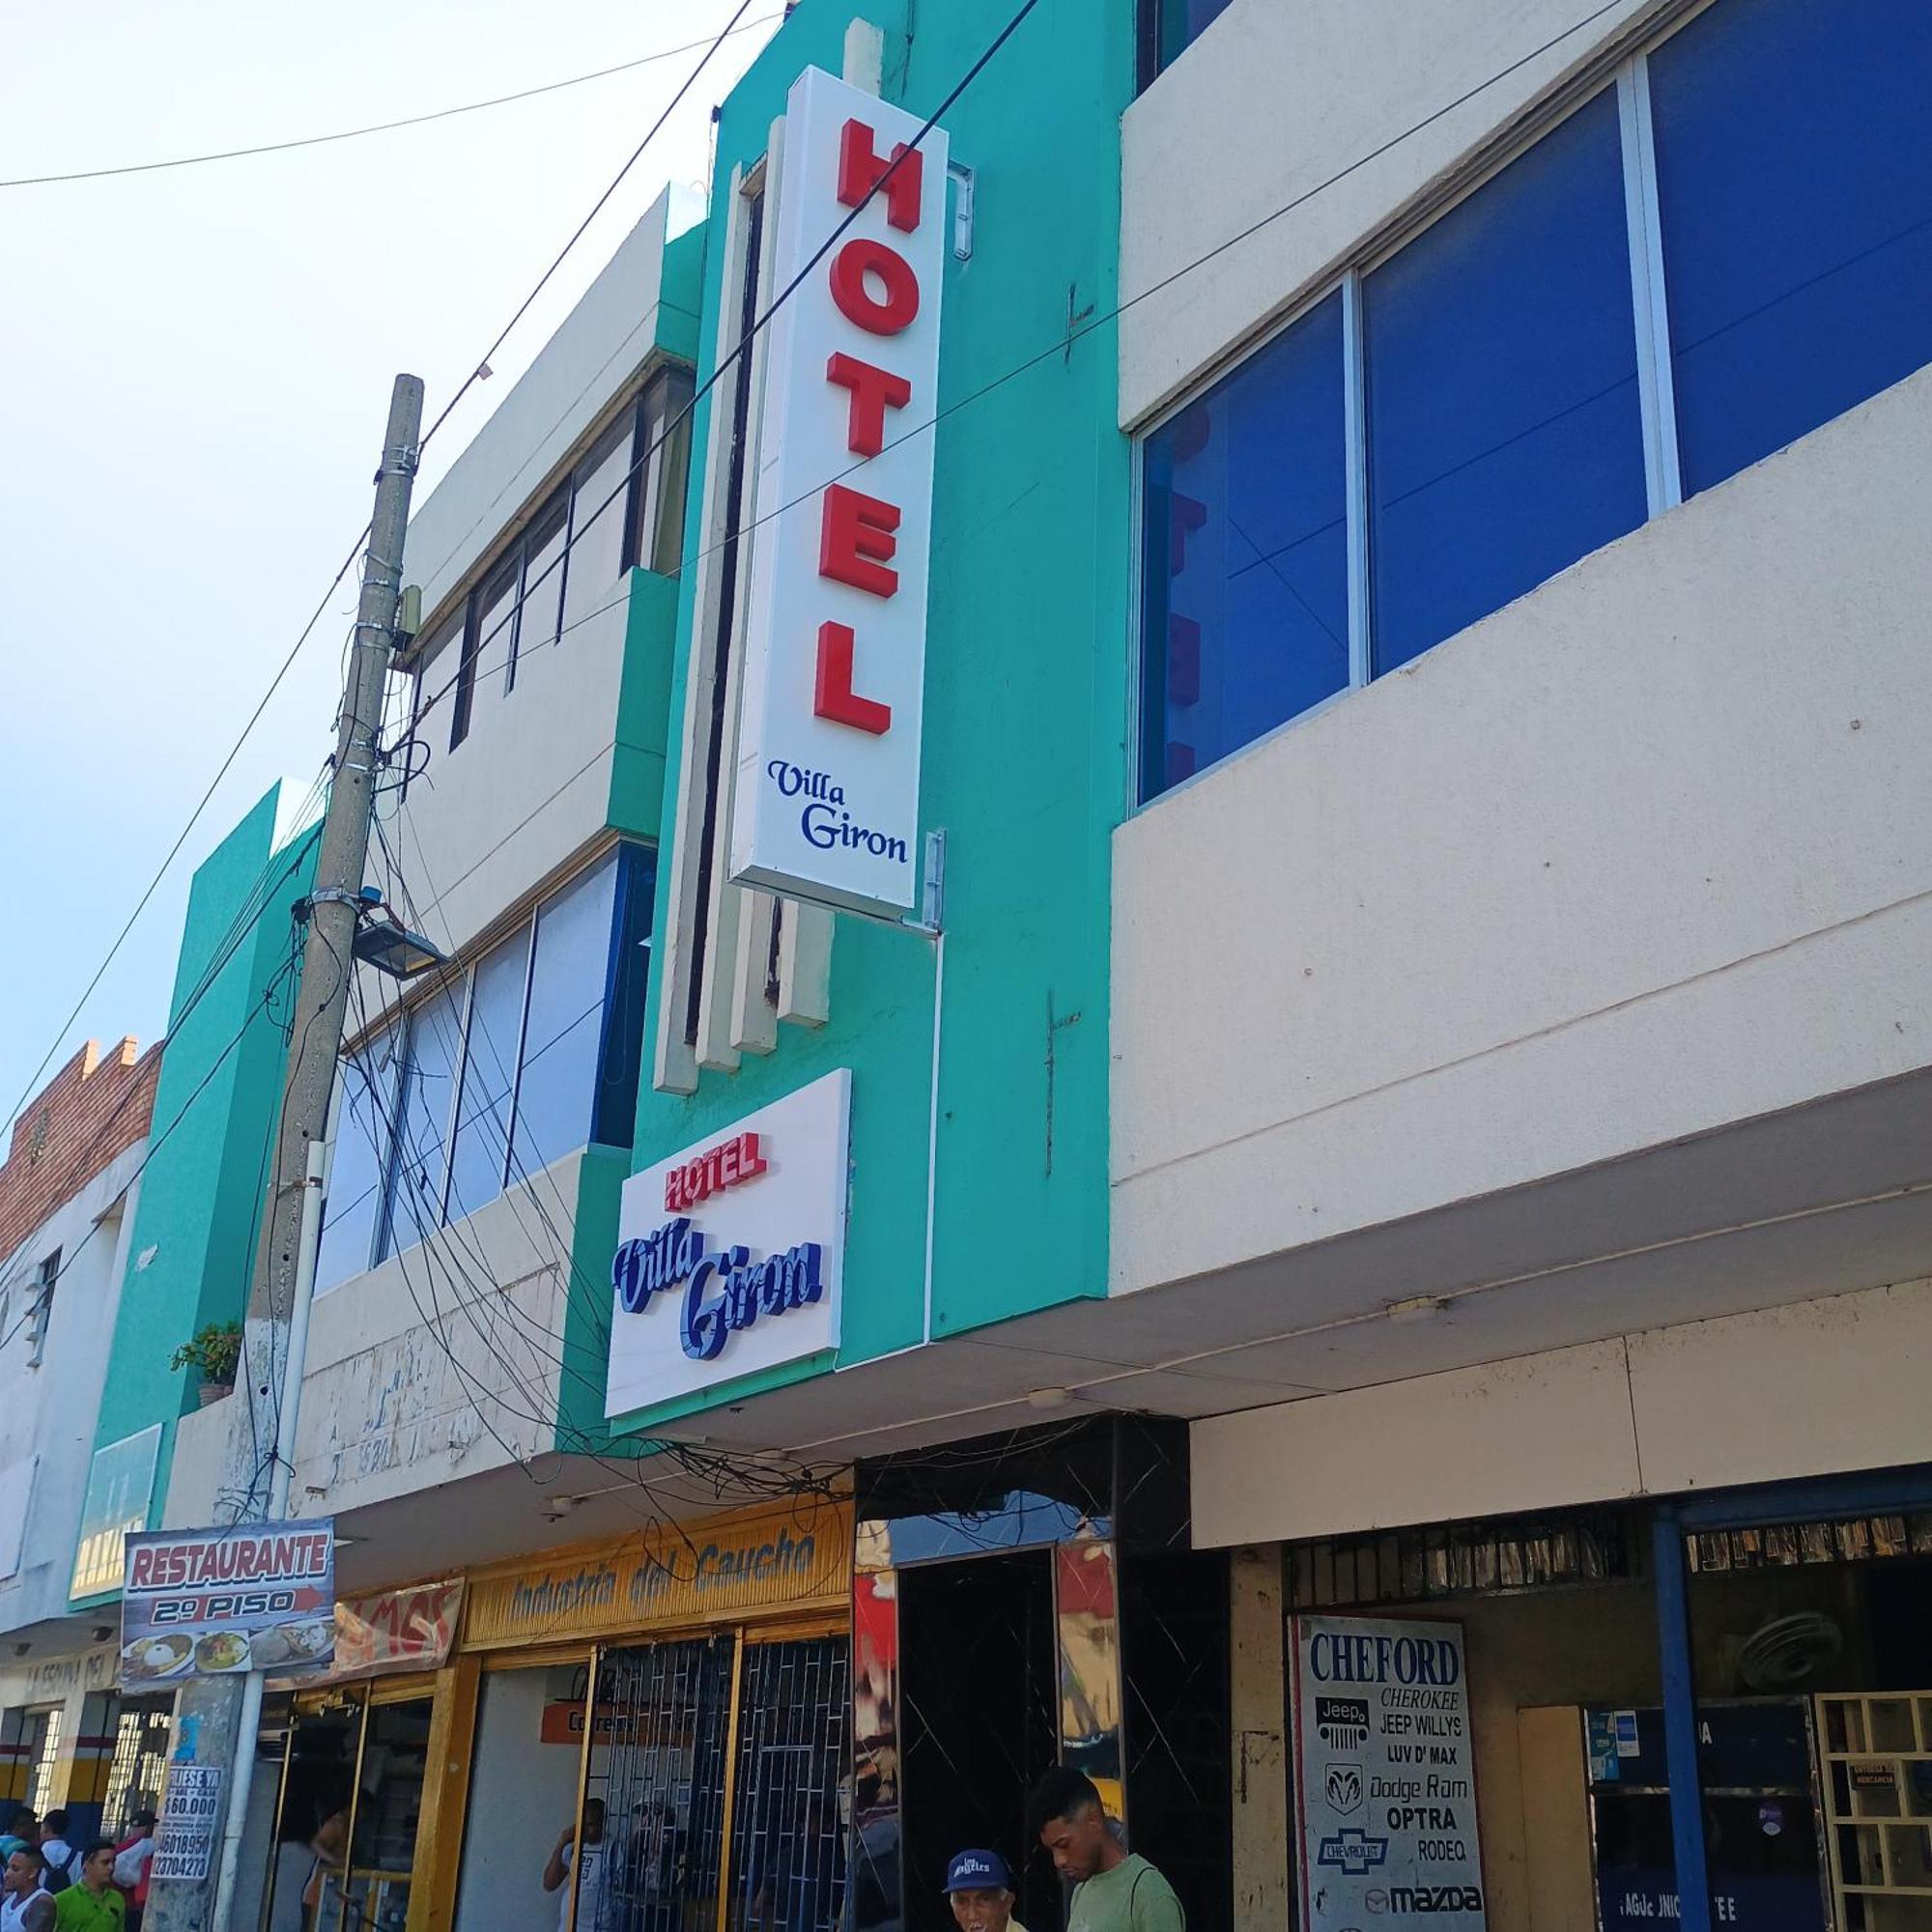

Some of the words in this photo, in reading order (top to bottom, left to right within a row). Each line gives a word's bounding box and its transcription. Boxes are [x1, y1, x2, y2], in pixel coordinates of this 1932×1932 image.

[814, 118, 923, 736] HOTEL
[768, 760, 845, 806] Villa
[802, 803, 907, 863] Giron
[665, 1132, 768, 1213] HOTEL
[611, 1217, 704, 1315] Villa
[680, 1243, 823, 1361] Giron
[129, 1532, 330, 1590] RESTAURANTE
[695, 1527, 815, 1593] Caucho
[205, 1590, 297, 1619] PISO
[1310, 1633, 1460, 1686] CHEFORD
[1322, 1701, 1360, 1722] Jeep
[1380, 1688, 1460, 1711] CHEROKEE
[1379, 1714, 1412, 1735] JEEP
[1415, 1715, 1462, 1737] WILLYS
[1387, 1745, 1411, 1763] LUV
[1430, 1747, 1457, 1765] MAX
[1370, 1776, 1421, 1804] Dodge
[1427, 1775, 1467, 1798] Ram
[1386, 1807, 1457, 1831] OPTRA
[1326, 1844, 1378, 1859] CHEVROLET
